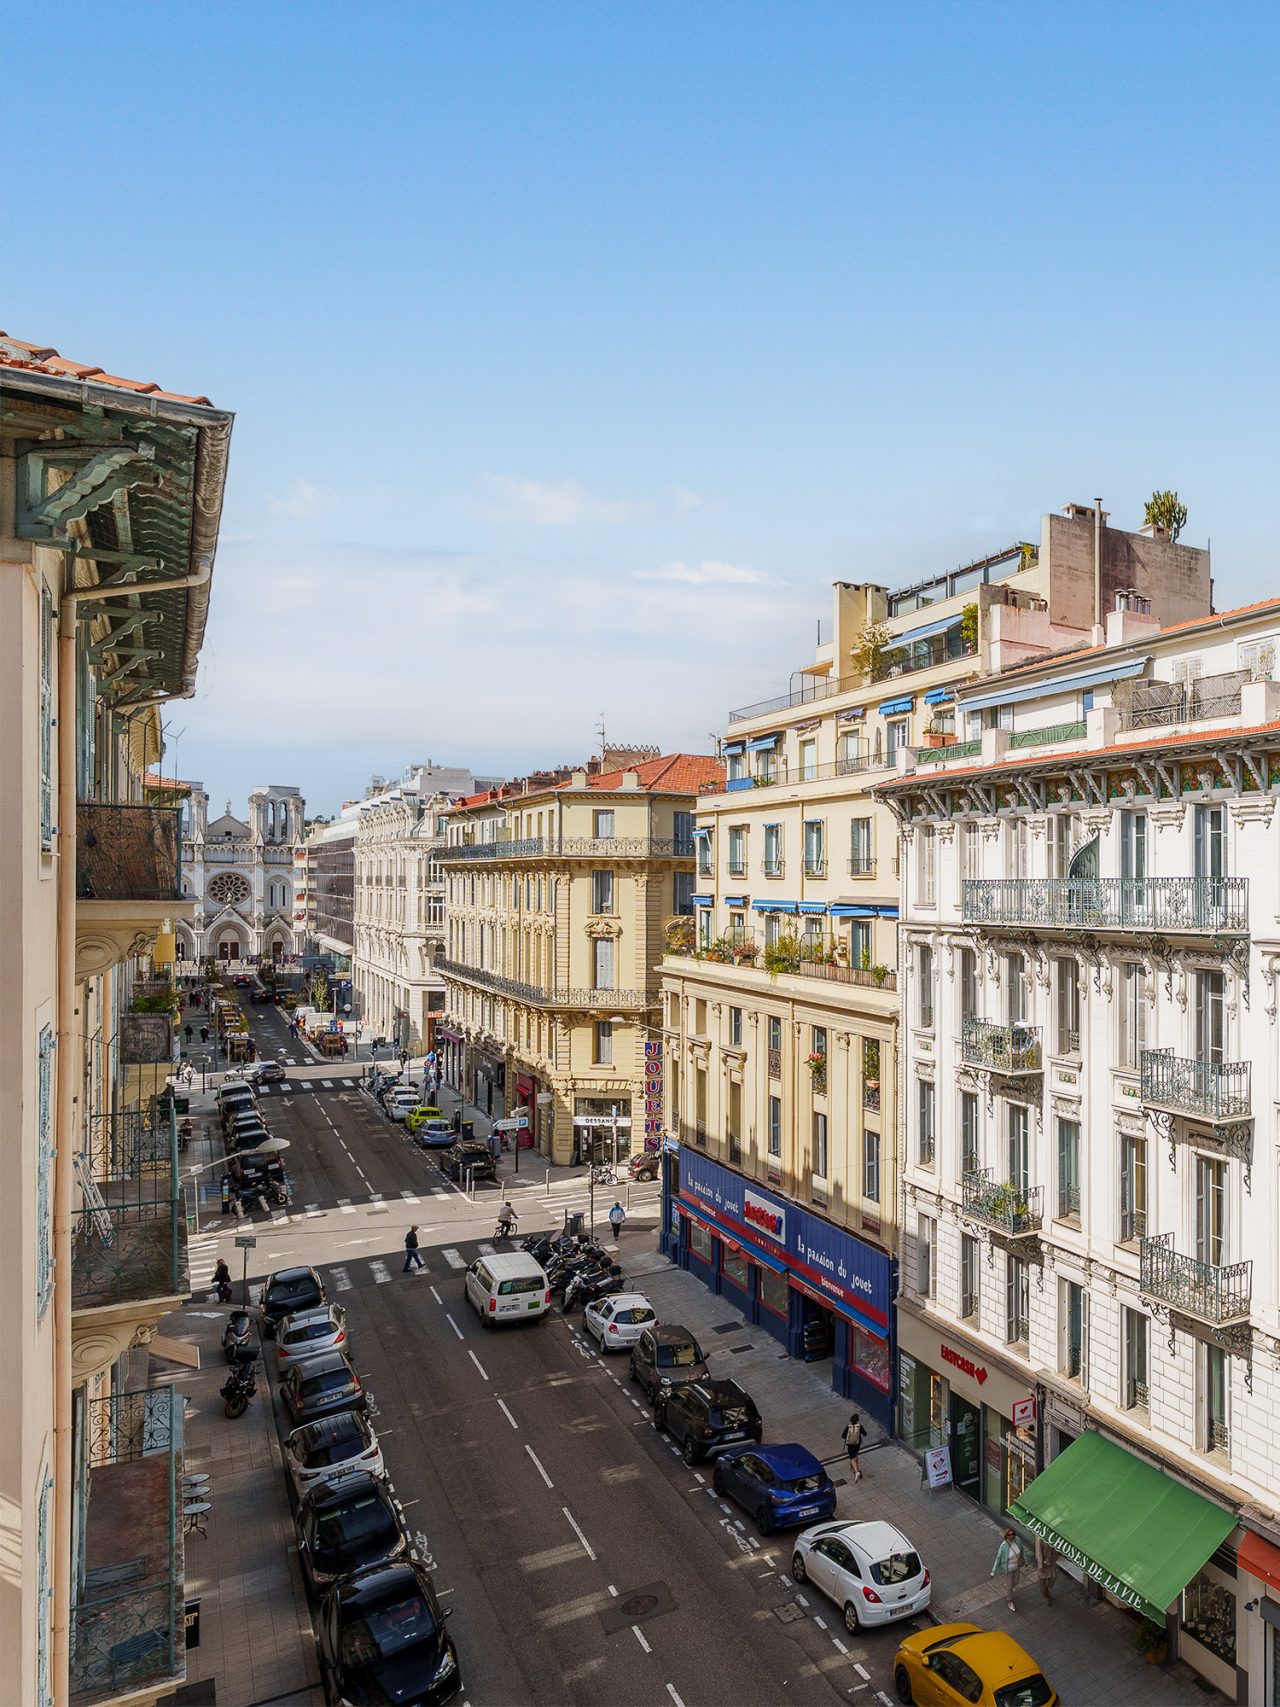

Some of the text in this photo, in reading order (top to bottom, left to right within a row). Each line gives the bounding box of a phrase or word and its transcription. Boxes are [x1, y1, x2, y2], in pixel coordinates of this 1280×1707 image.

[645, 1042, 660, 1152] JOUETS
[694, 1181, 713, 1198] passion
[715, 1187, 722, 1204] du
[723, 1198, 739, 1214] jouet
[807, 1246, 834, 1272] passion
[837, 1259, 847, 1278] du
[850, 1274, 873, 1295] jouet
[820, 1275, 844, 1297] bienvenue
[1026, 1517, 1143, 1609] LES CHOSES DE LA VIE
